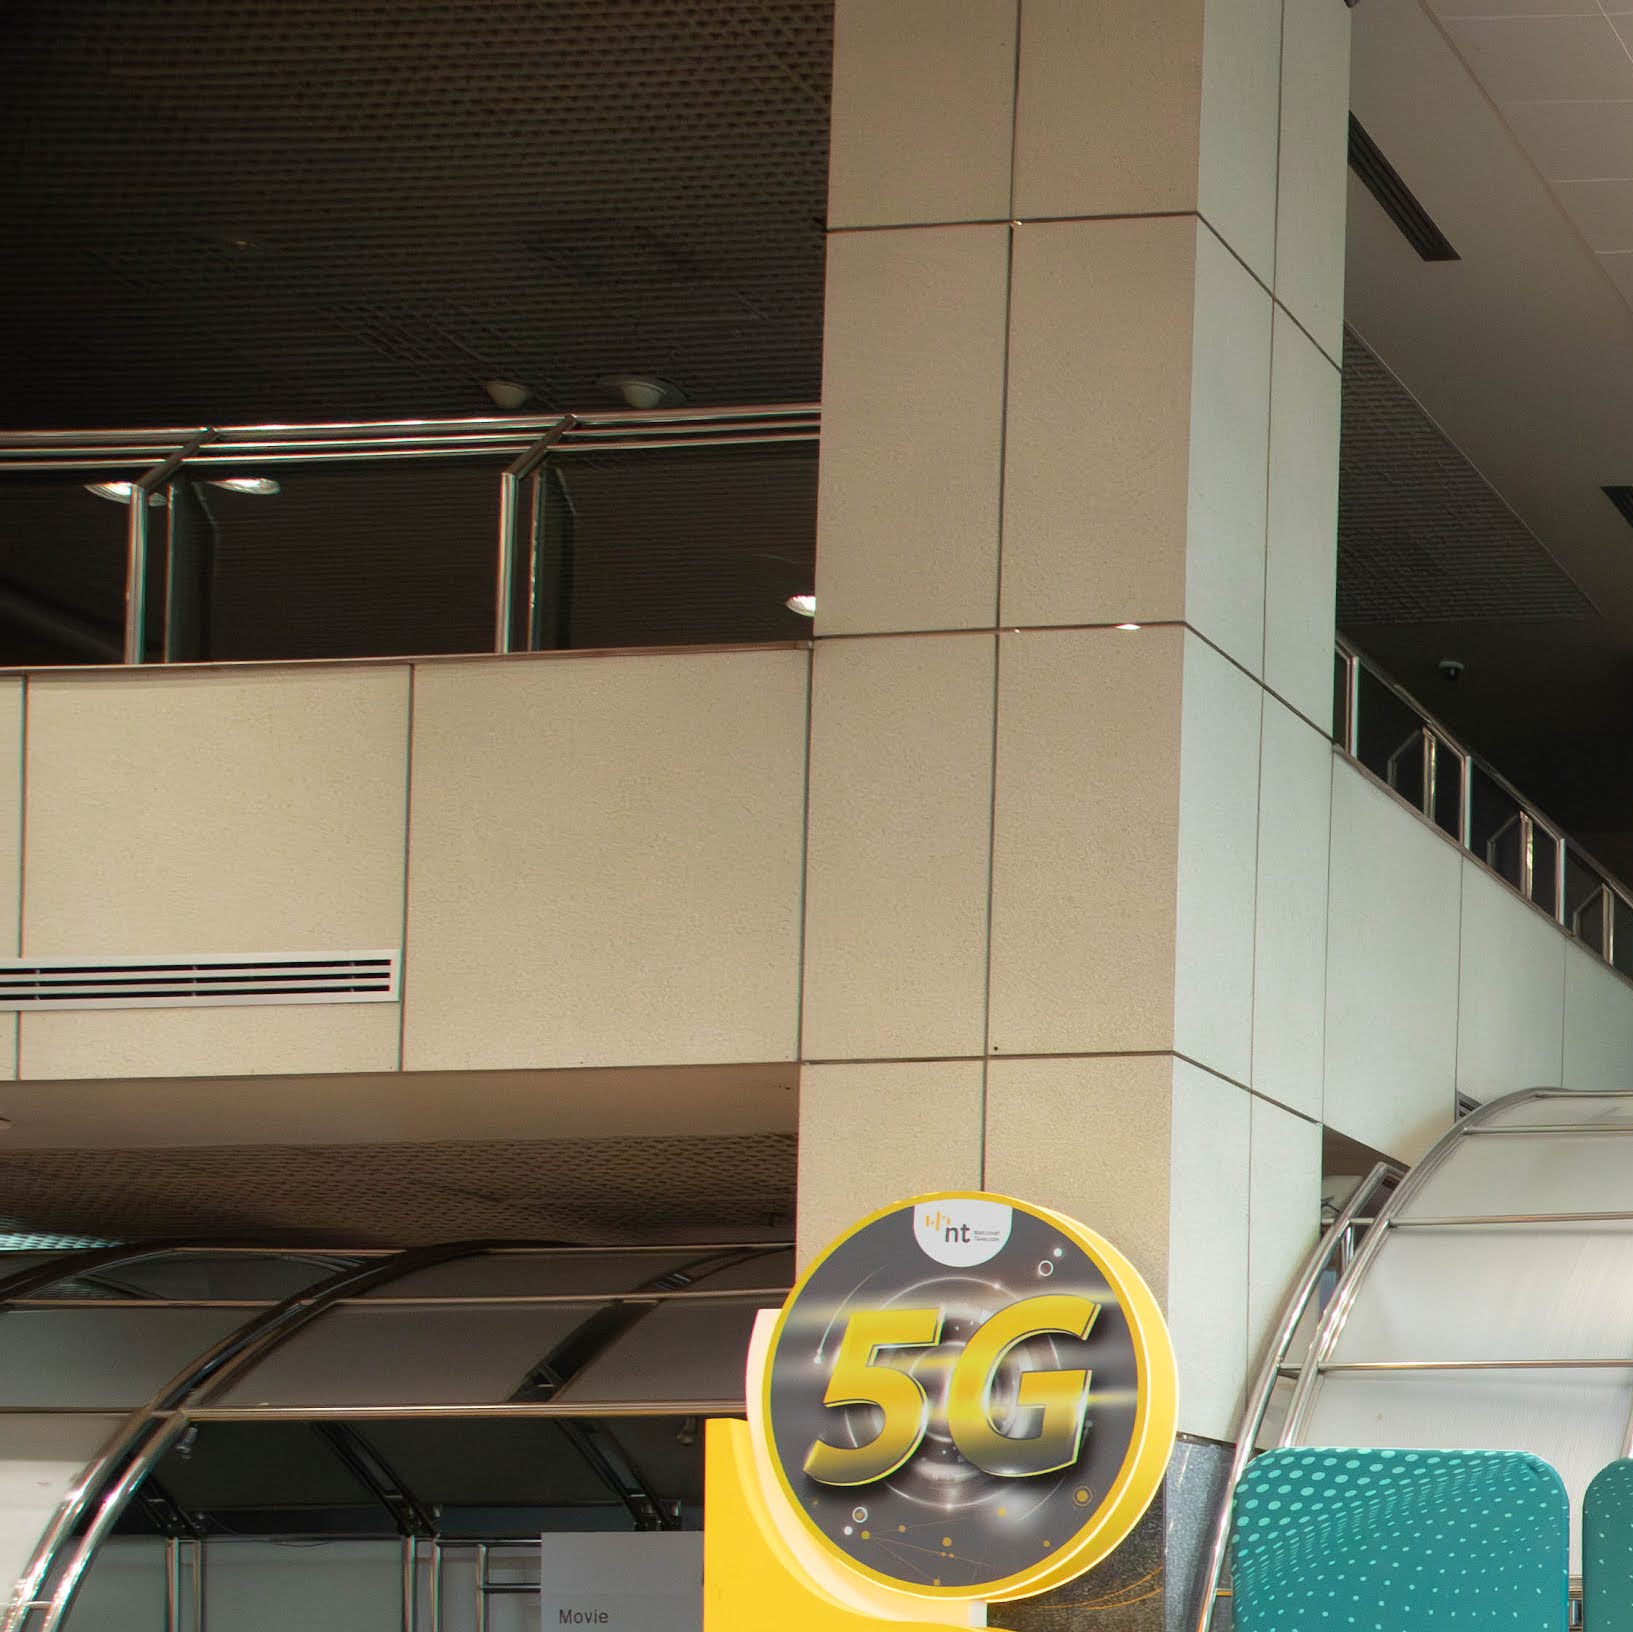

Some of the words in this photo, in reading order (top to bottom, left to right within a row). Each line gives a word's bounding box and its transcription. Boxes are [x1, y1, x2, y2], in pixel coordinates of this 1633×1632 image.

[946, 1224, 970, 1244] nt
[803, 1294, 1101, 1487] 5G
[560, 1609, 608, 1624] Movie
